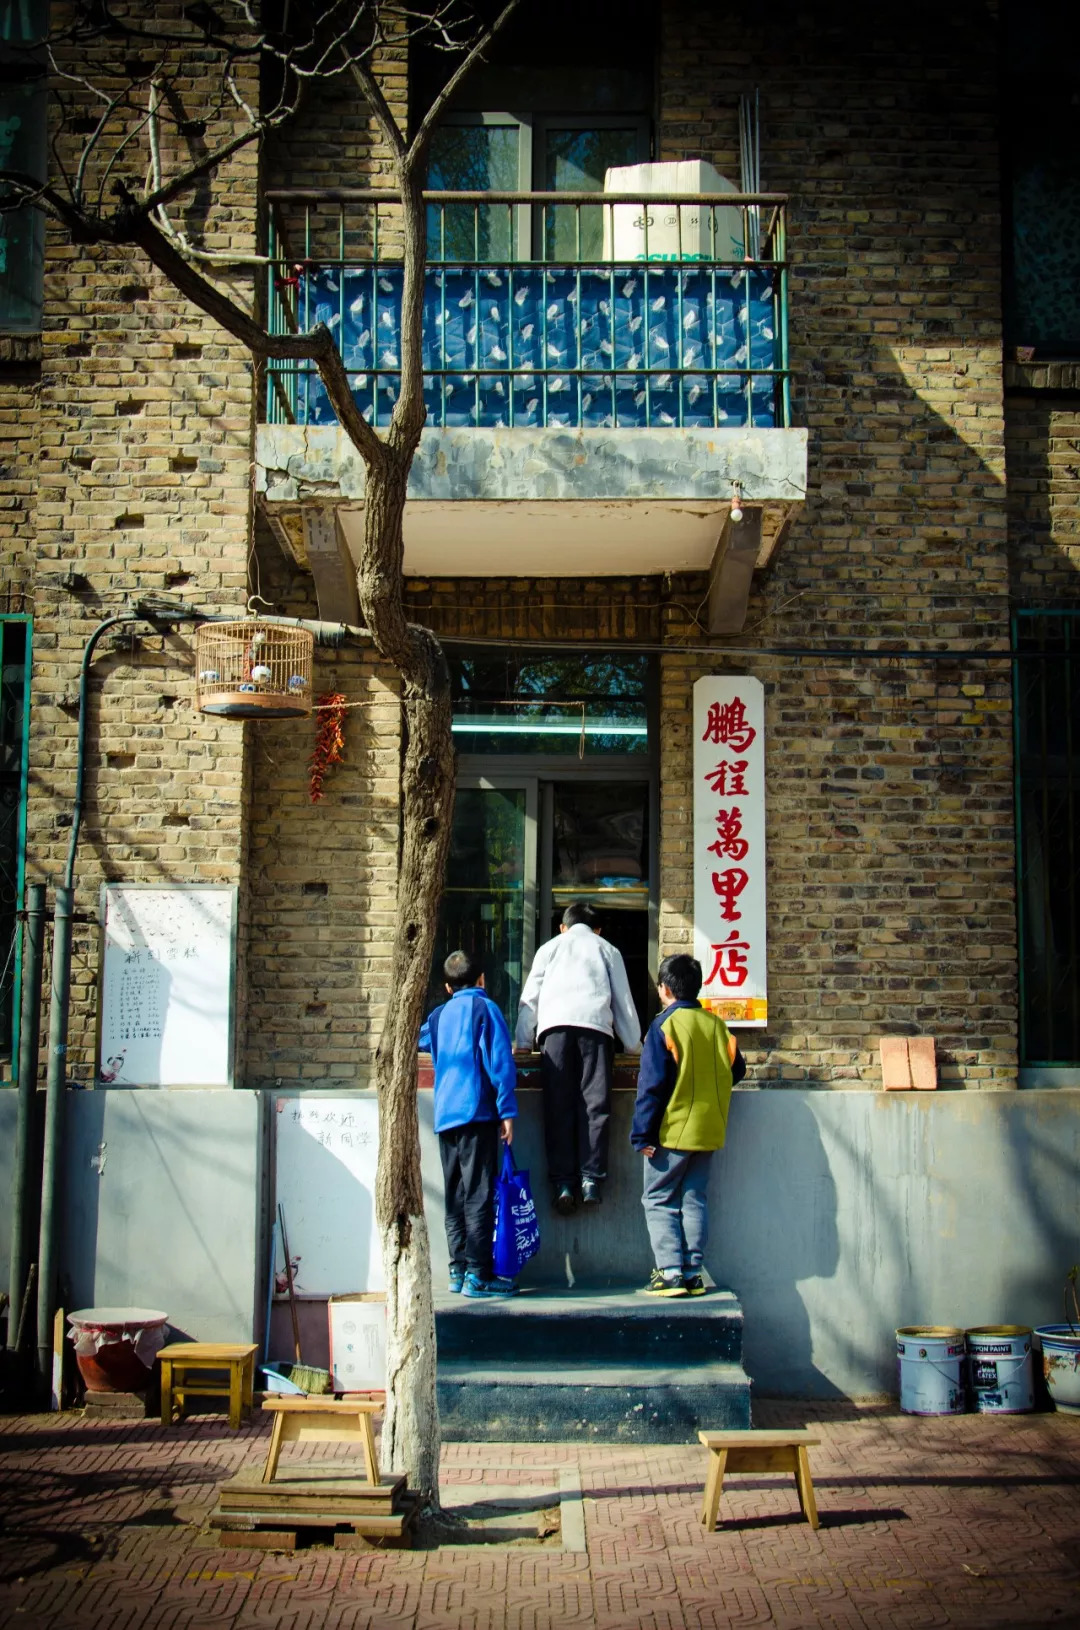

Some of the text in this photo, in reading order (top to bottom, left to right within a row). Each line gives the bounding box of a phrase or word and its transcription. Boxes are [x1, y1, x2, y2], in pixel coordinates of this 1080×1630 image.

[702, 696, 757, 987] 鵬程萬里店
[124, 945, 199, 964] 新到雪糕
